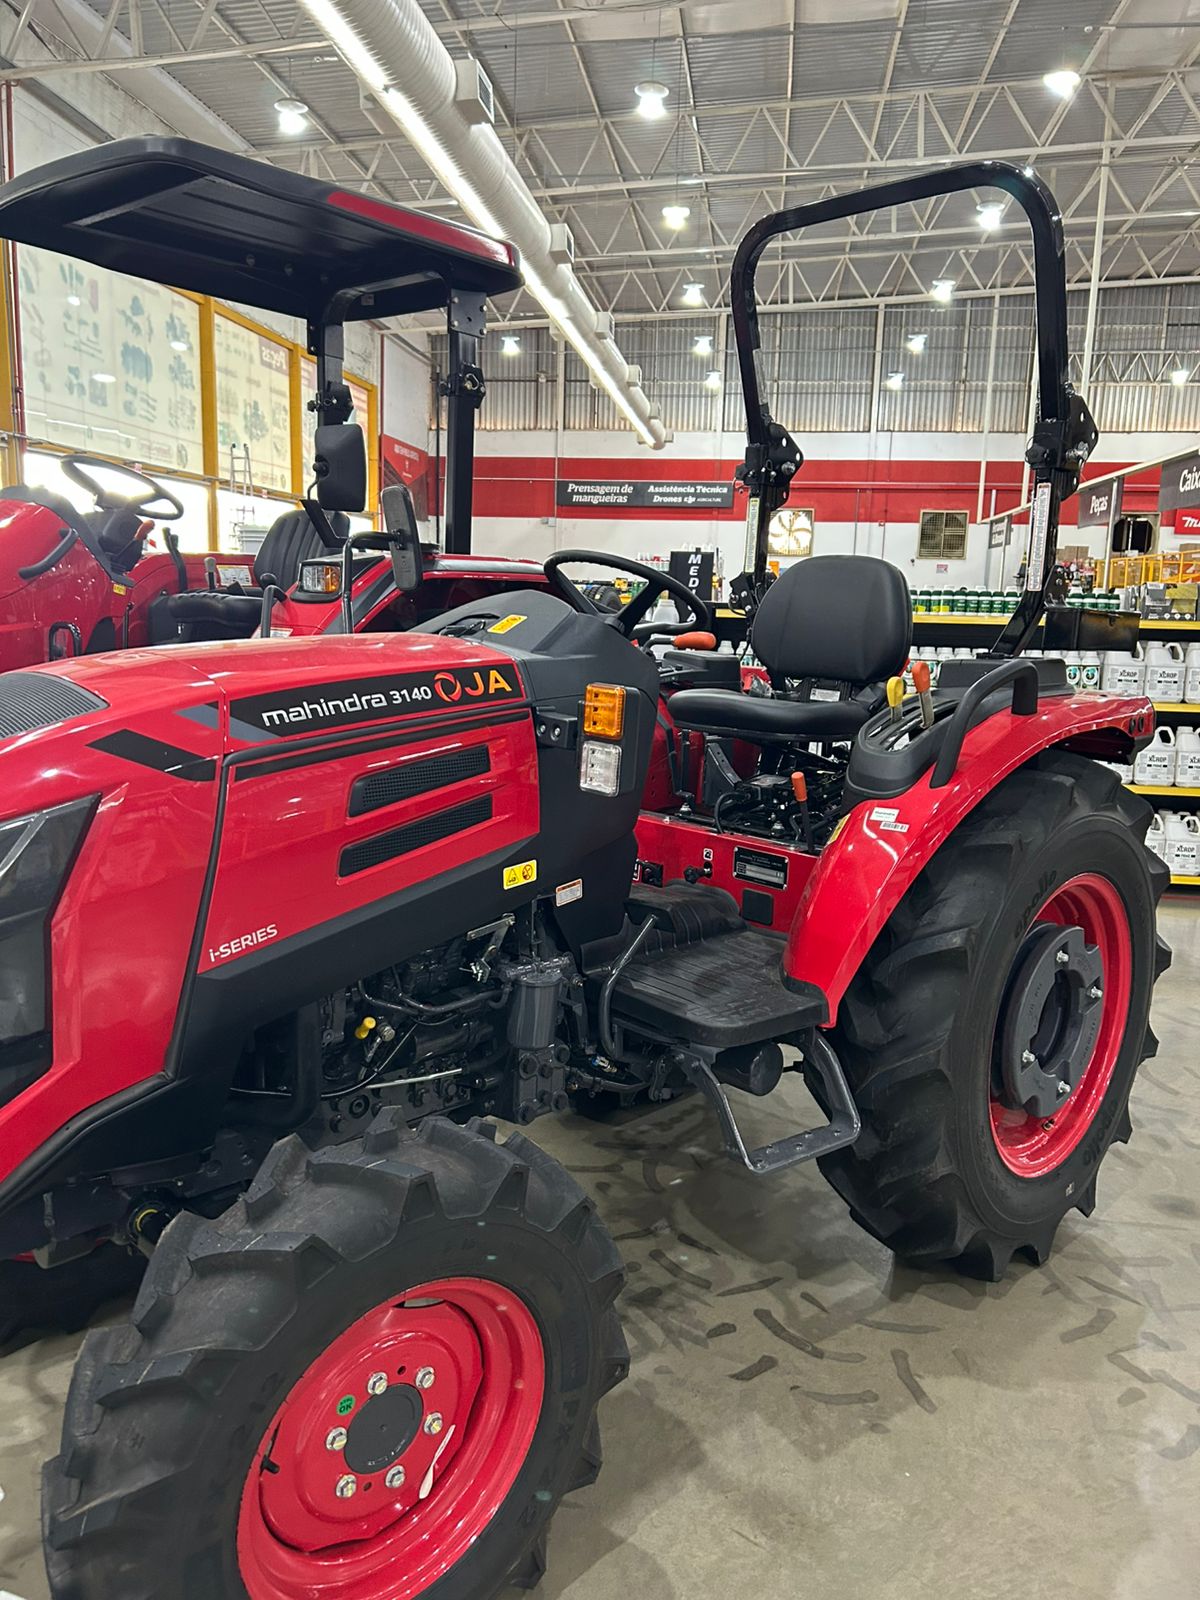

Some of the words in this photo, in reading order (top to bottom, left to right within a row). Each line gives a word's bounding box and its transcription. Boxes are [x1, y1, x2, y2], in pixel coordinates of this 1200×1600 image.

[567, 483, 619, 494] Prensagem
[621, 484, 633, 493] de
[573, 494, 628, 504] mangueiras
[653, 495, 682, 503] Drones
[1090, 496, 1108, 516] Peças
[261, 692, 387, 727] mahindra
[389, 686, 432, 705] 3140
[434, 670, 512, 702] OJA
[209, 924, 278, 962] i-SERIES
[339, 1403, 352, 1413] OK
